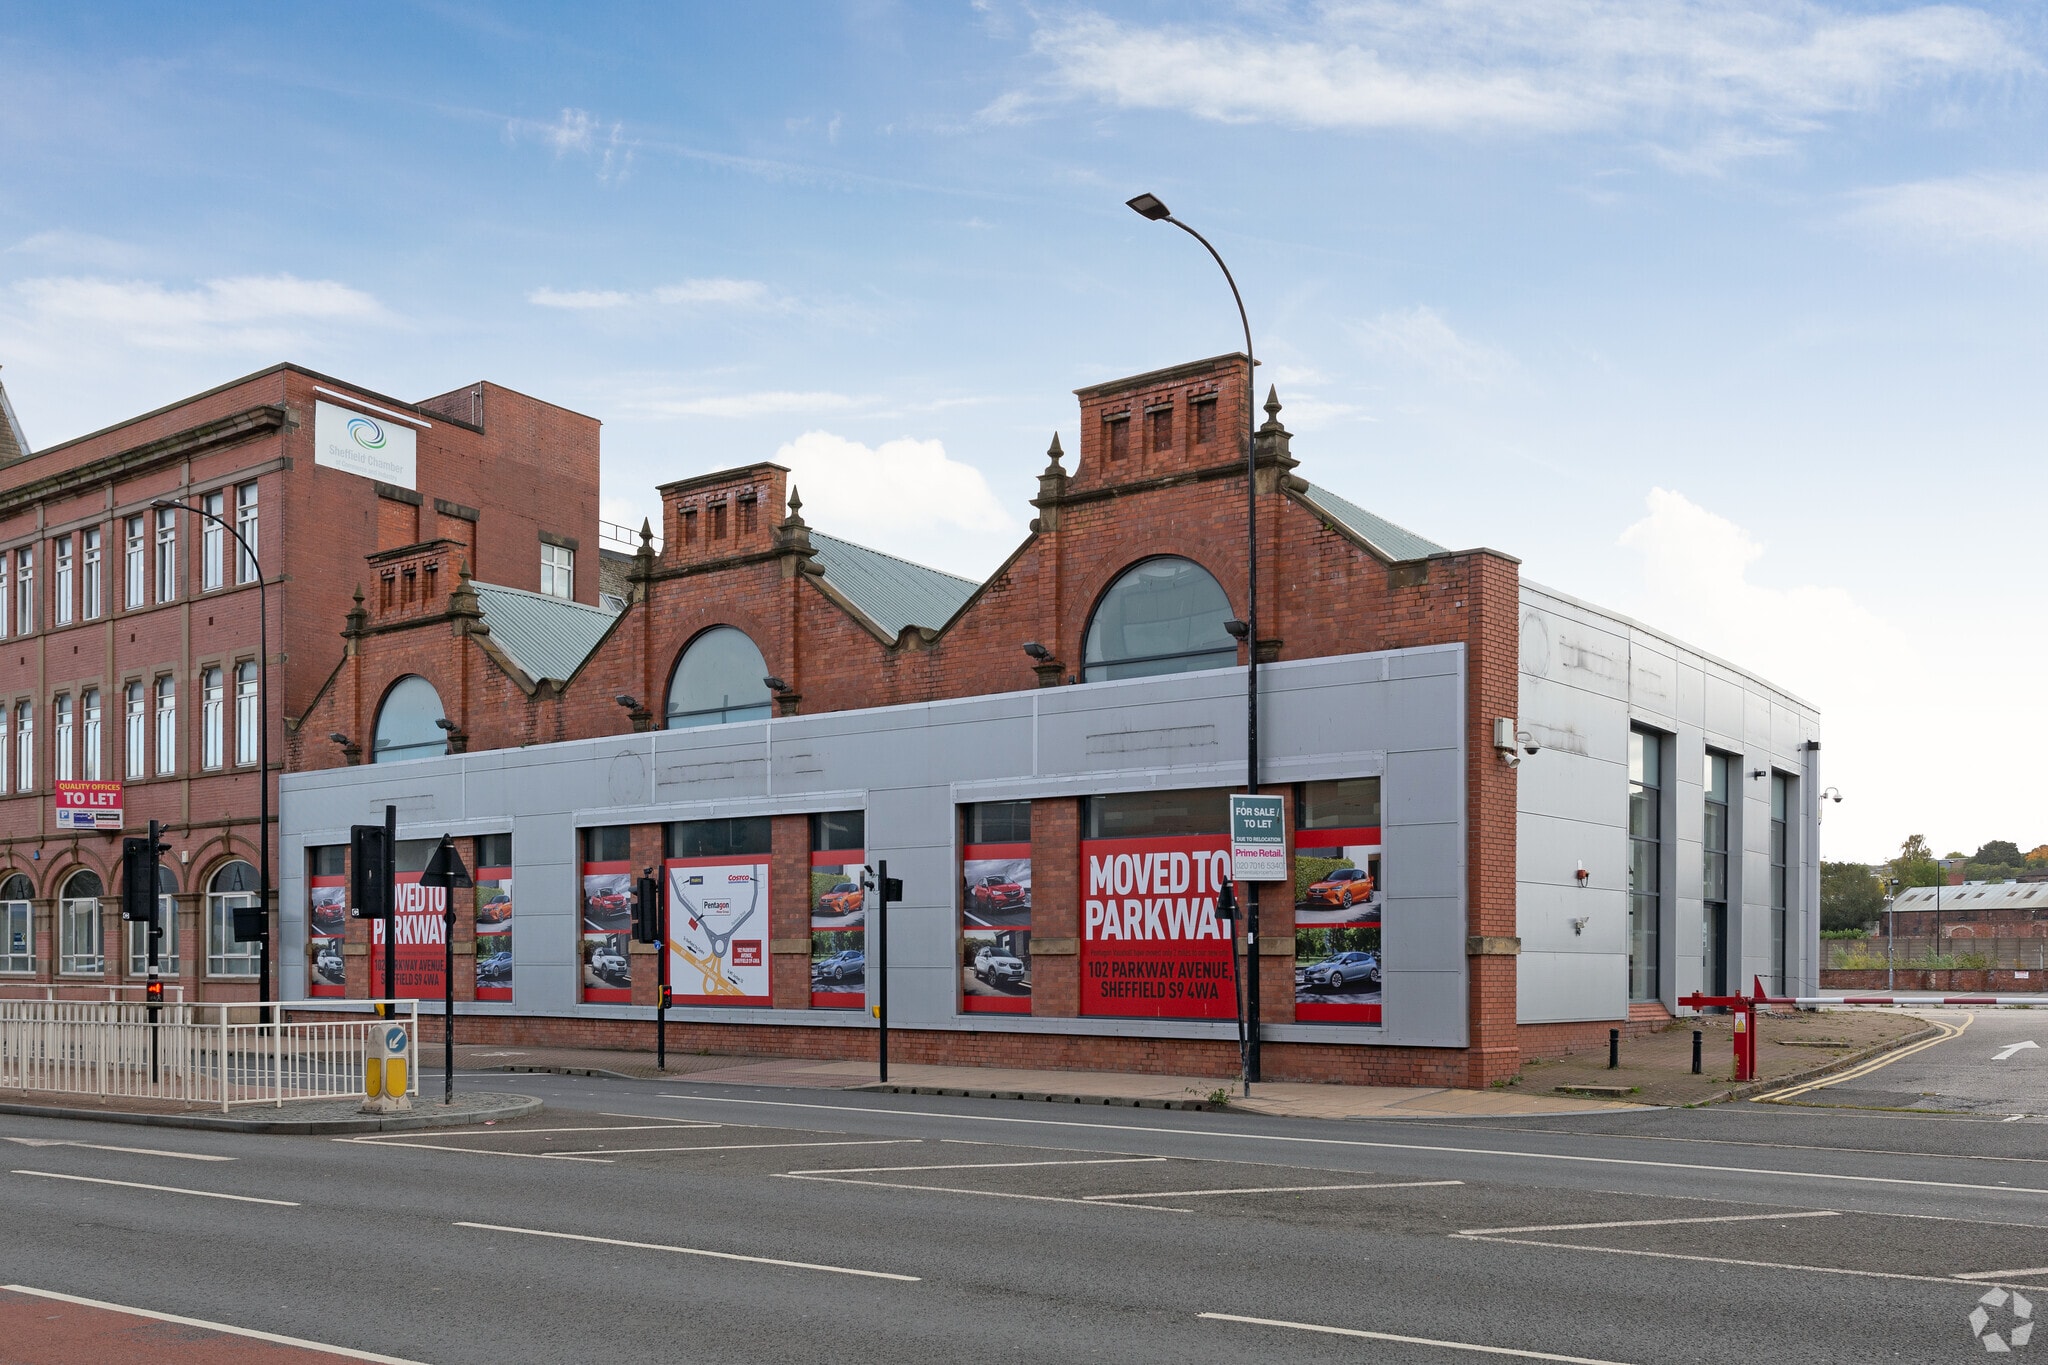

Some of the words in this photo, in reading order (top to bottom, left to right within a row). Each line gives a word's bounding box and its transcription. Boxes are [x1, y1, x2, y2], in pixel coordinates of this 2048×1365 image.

[329, 444, 366, 464] Sheffield
[367, 455, 404, 474] Chamber
[63, 791, 86, 805] TO
[89, 792, 117, 806] LET
[1235, 807, 1253, 816] FOR
[1254, 807, 1275, 817] SALE
[1244, 819, 1256, 829] TO
[1257, 819, 1273, 829] LET
[1235, 848, 1258, 857] Prime
[1259, 849, 1283, 858] Retail.
[1089, 852, 1190, 896] MOVED
[1192, 849, 1231, 893] TO
[1236, 862, 1249, 870] 020
[1249, 862, 1265, 870] 7016
[395, 882, 426, 913] VED
[704, 901, 730, 910] Pentagon
[1088, 961, 1109, 978] 102
[1112, 961, 1175, 979] PARKWAY
[1178, 961, 1233, 982] AVENUE,
[414, 974, 422, 986] S9
[423, 974, 440, 987] 4WA
[1101, 981, 1166, 999] SHEFFIELD
[1168, 981, 1184, 999] S9
[1187, 982, 1219, 1000] 4WA
